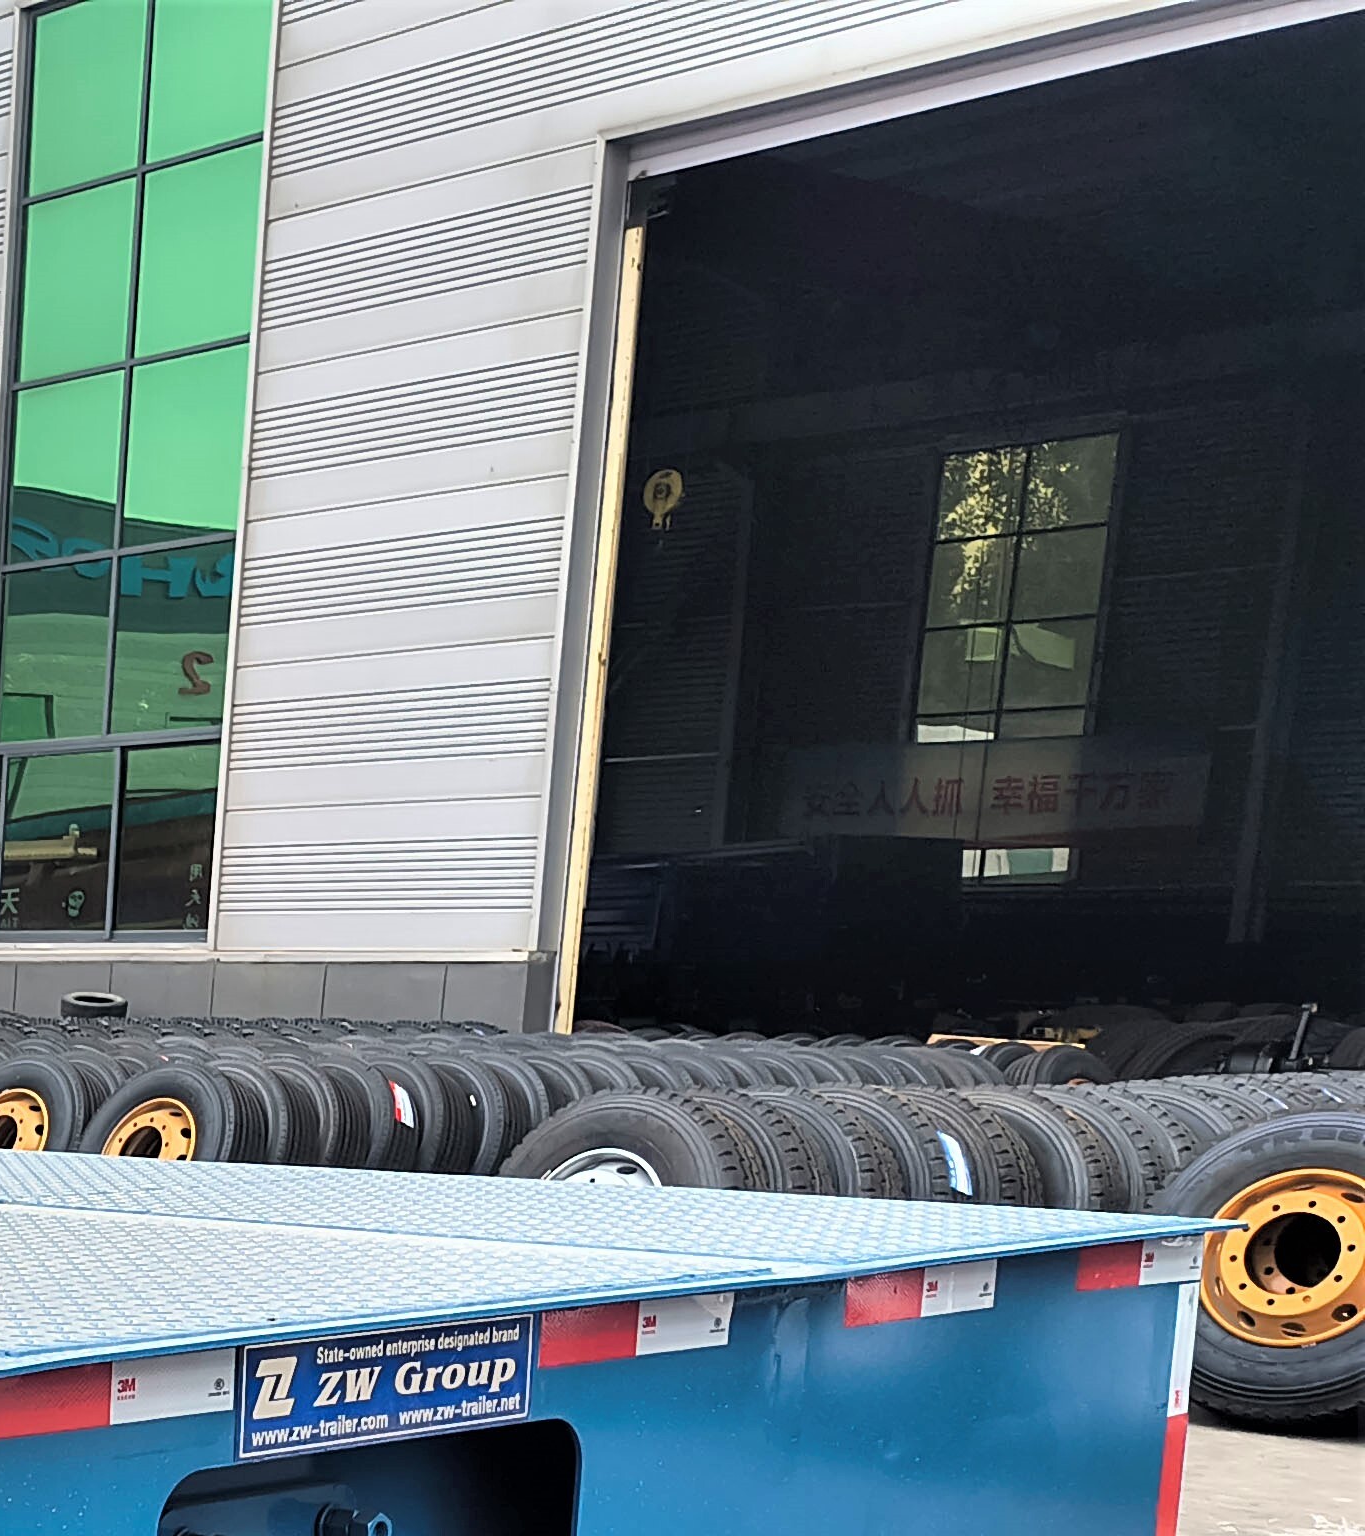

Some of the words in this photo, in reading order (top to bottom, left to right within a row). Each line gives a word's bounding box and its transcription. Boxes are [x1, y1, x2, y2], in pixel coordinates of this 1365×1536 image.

[642, 1314, 657, 1329] 3M
[316, 1339, 384, 1365] State-owned
[385, 1333, 436, 1357] enterprise
[437, 1328, 492, 1351] designated
[491, 1323, 521, 1343] brand
[117, 1377, 136, 1394] 3M
[312, 1365, 381, 1408] ZW
[393, 1356, 518, 1397] Group
[251, 1412, 389, 1447] www.zw-trailer.com
[398, 1391, 521, 1427] www.zw-trailer.net
